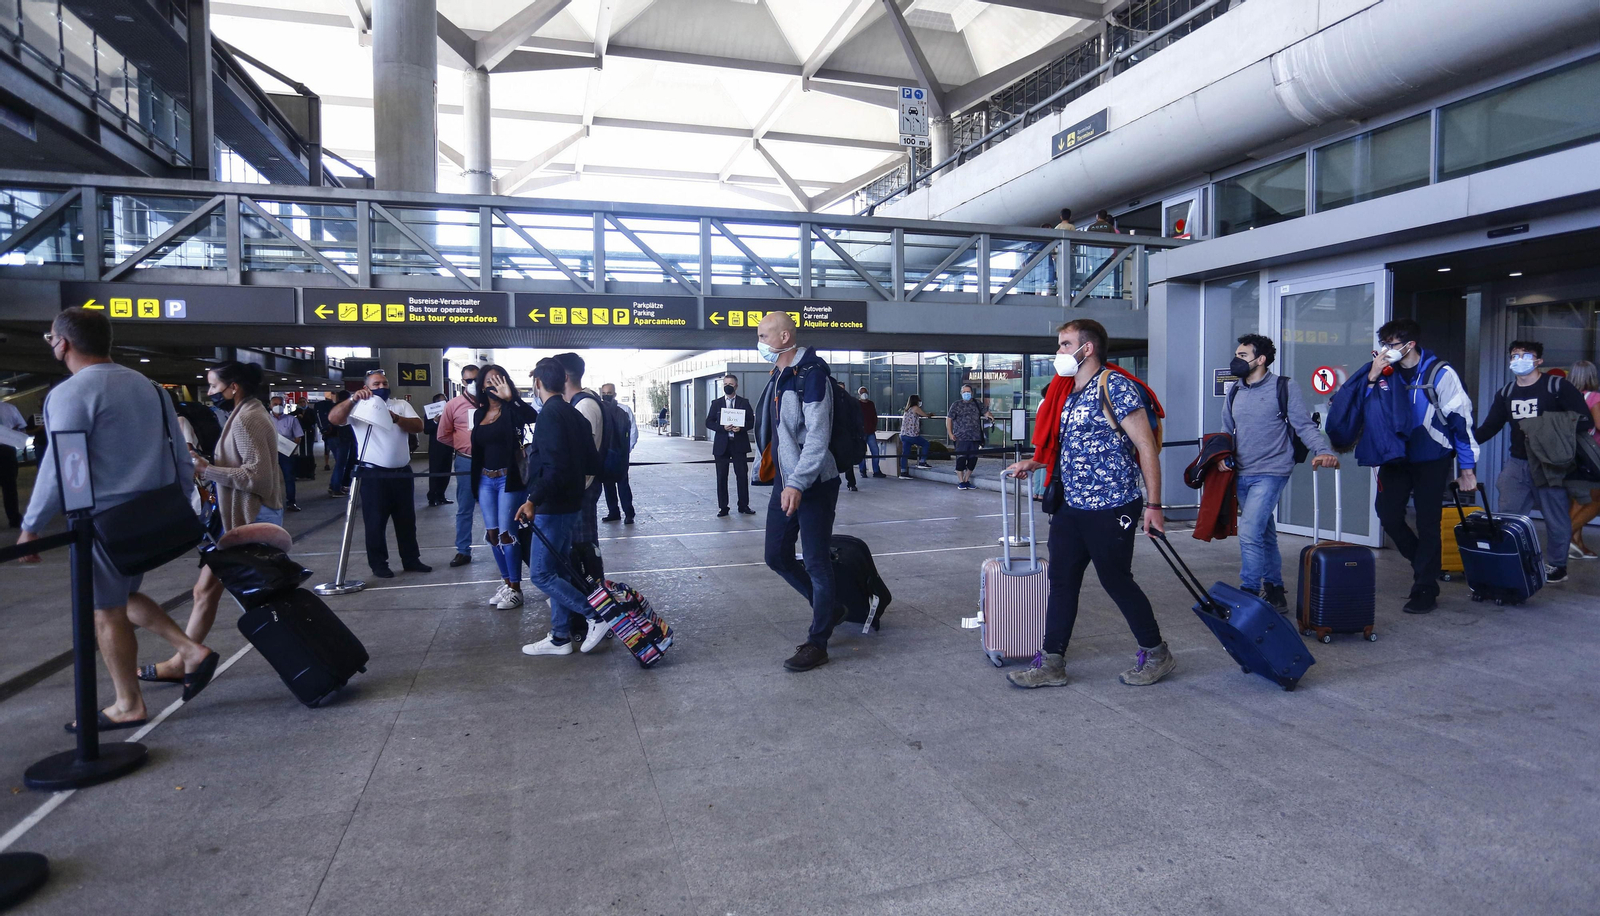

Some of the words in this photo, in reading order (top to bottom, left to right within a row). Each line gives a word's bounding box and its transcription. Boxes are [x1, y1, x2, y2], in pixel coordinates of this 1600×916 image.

[1077, 128, 1095, 141] Terminal
[408, 297, 481, 306] Busreise-Veranstalter
[632, 301, 664, 309] Parkplätze
[169, 302, 182, 316] P
[408, 305, 423, 313] Bus
[424, 306, 439, 314] tour
[633, 309, 656, 318] Parking
[803, 305, 833, 313] Autoverleih
[409, 313, 426, 322] Bus
[428, 314, 447, 322] tour
[448, 315, 498, 324] operadores
[616, 310, 626, 323] P
[803, 312, 813, 320] Car
[633, 317, 686, 326] Aparcamiento
[803, 320, 829, 329] Alquiler
[830, 320, 839, 328] de
[839, 321, 863, 329] coches
[1511, 398, 1538, 420] DC
